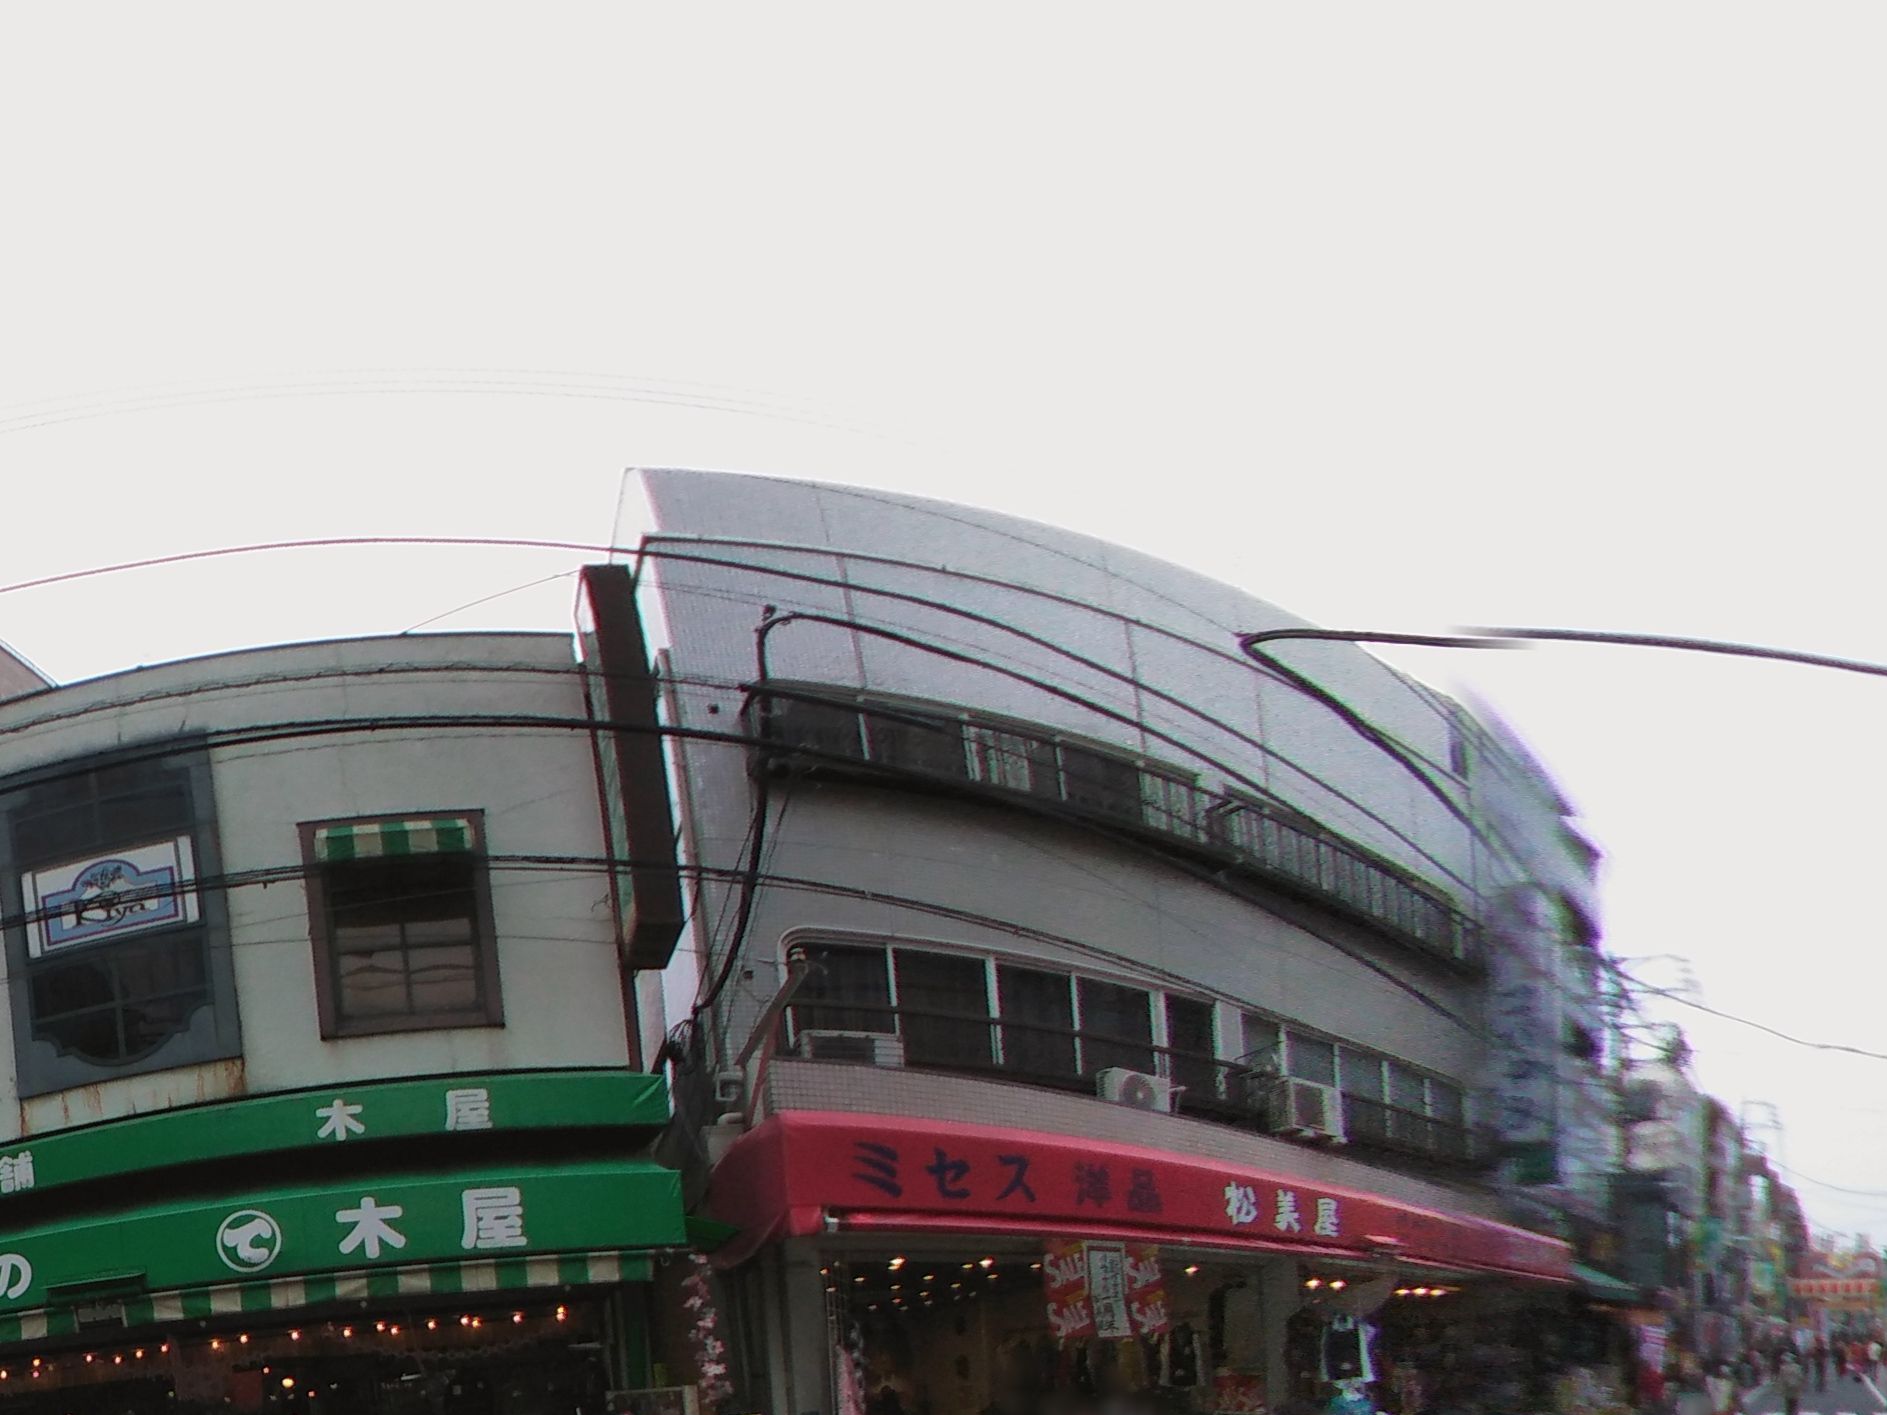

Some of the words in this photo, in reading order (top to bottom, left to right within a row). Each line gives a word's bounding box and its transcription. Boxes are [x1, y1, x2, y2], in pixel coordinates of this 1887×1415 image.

[315, 1088, 494, 1142] 木屋
[852, 1139, 1038, 1204] ミセス
[1223, 1180, 1341, 1238] 松美屋
[335, 1186, 528, 1260] 木屋
[1043, 1251, 1087, 1289] SALE
[1125, 1255, 1162, 1289] SALE
[1046, 1300, 1092, 1337] SALE
[1130, 1299, 1169, 1335] SALE
